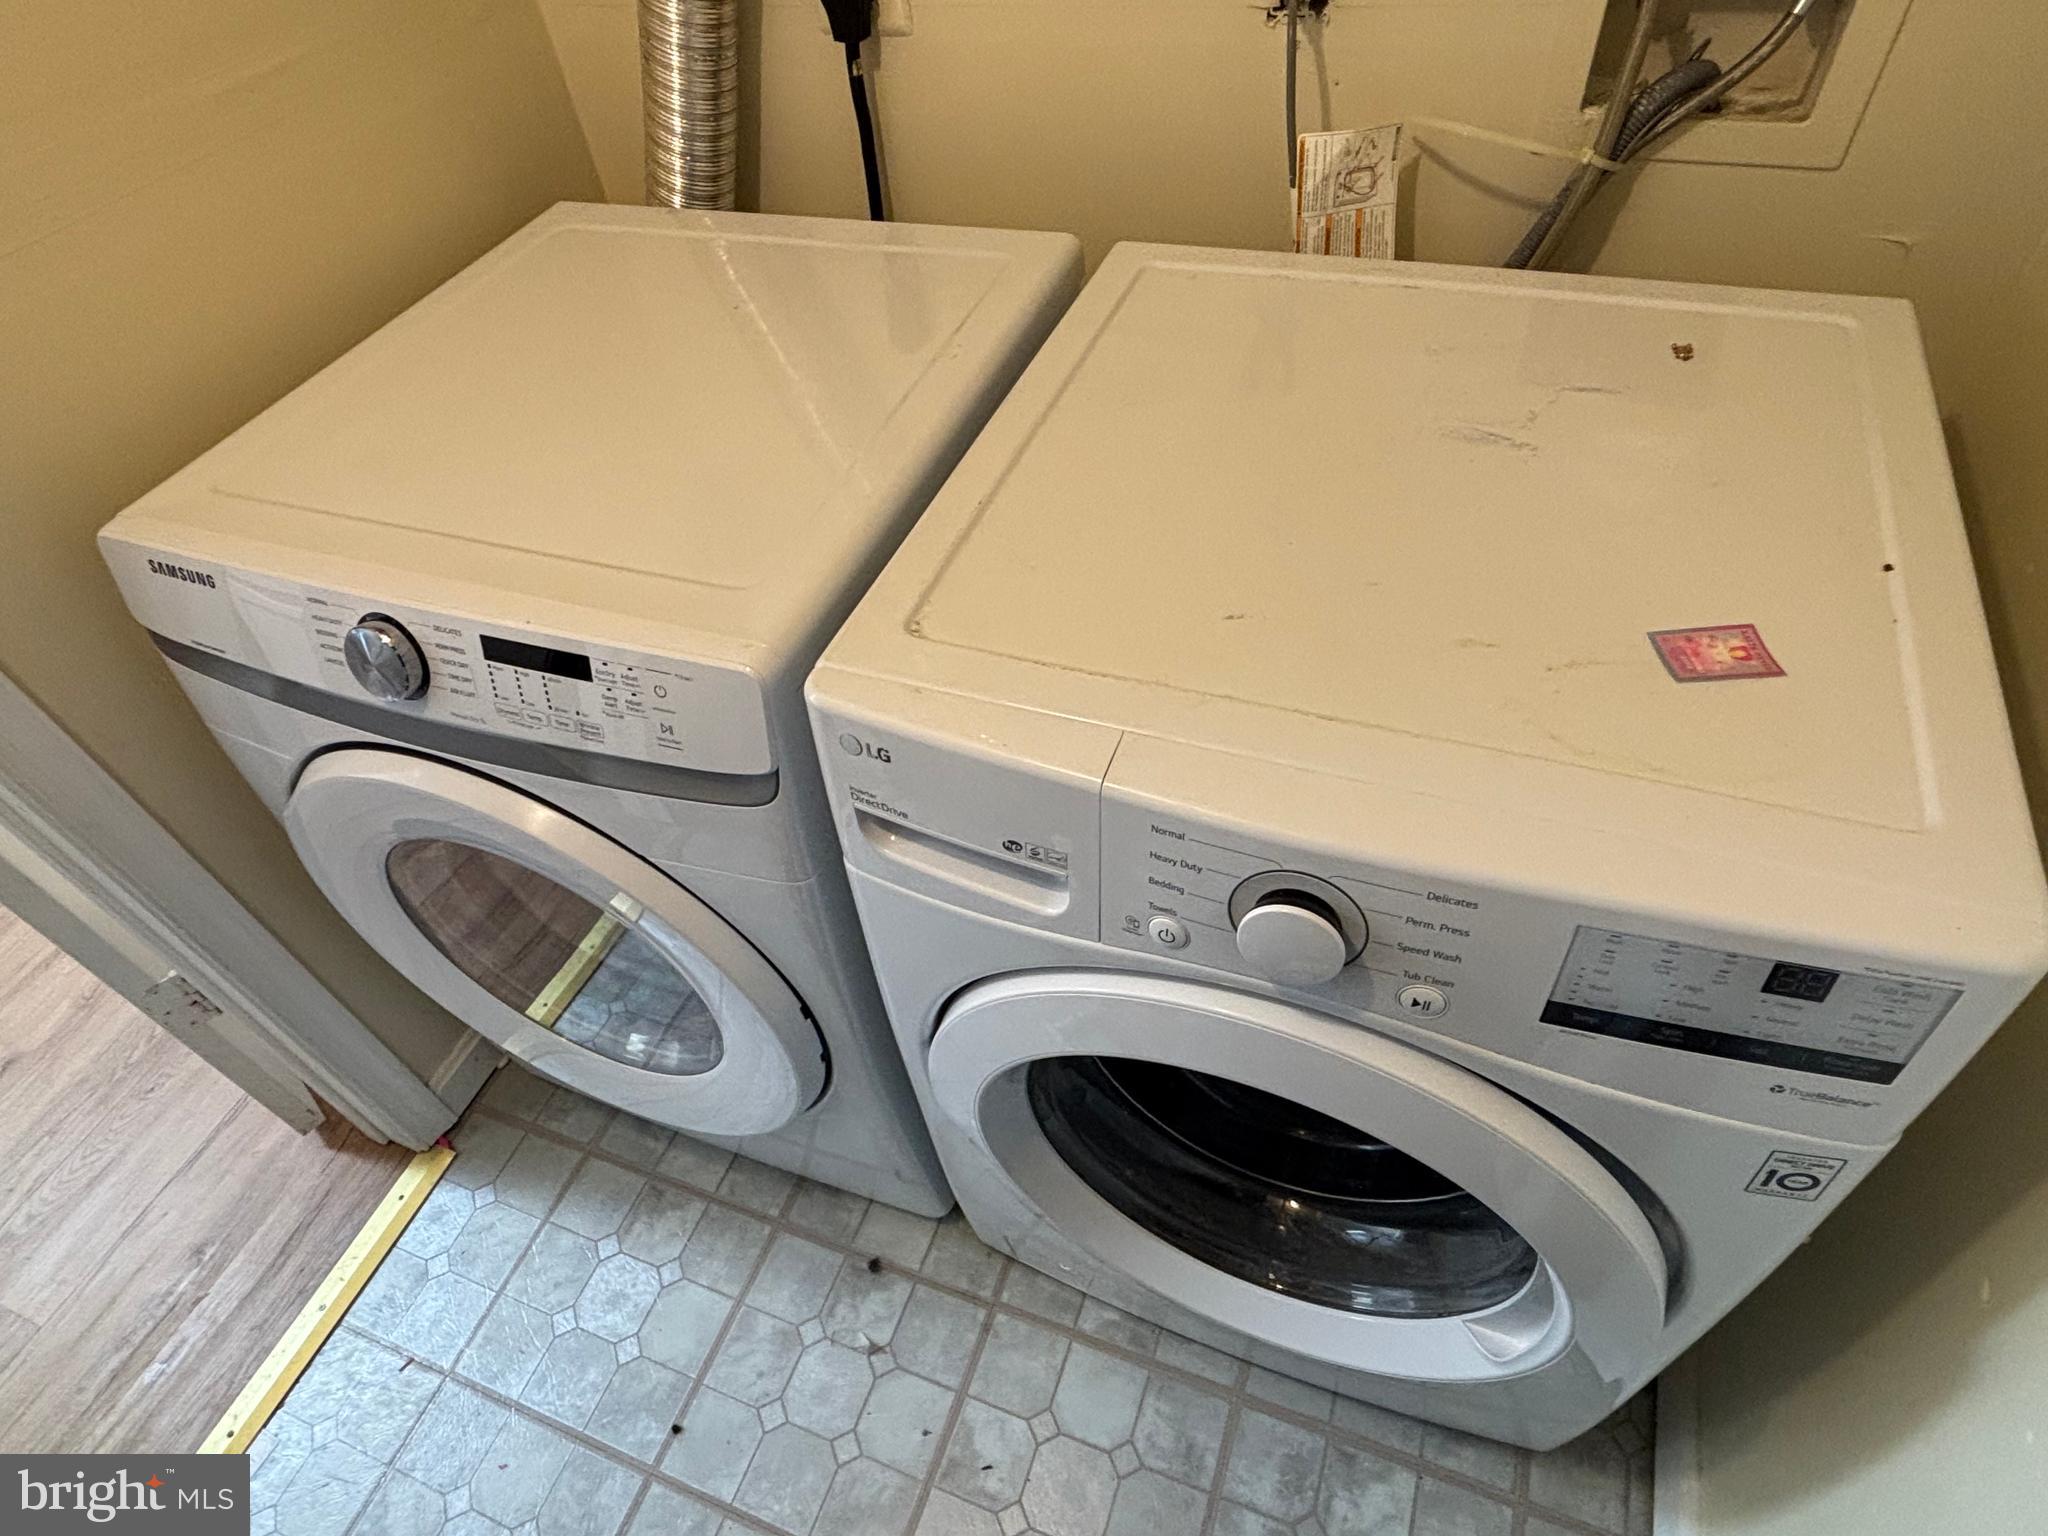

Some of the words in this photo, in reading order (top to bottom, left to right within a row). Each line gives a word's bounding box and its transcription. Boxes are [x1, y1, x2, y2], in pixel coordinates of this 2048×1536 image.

[148, 559, 216, 589] SAMSUNG
[865, 743, 892, 764] LG
[1151, 825, 1186, 841] Normal
[1149, 851, 1178, 867] Heavy
[1180, 860, 1203, 875] Duty
[1148, 876, 1185, 896] Bedding
[1147, 901, 1178, 917] Towels
[1426, 891, 1479, 910] Delicates
[1440, 923, 1471, 938] Press
[1397, 942, 1430, 957] Speed
[1433, 950, 1462, 964] Wash
[1403, 969, 1421, 982] Tub
[1424, 975, 1455, 989] Clean
